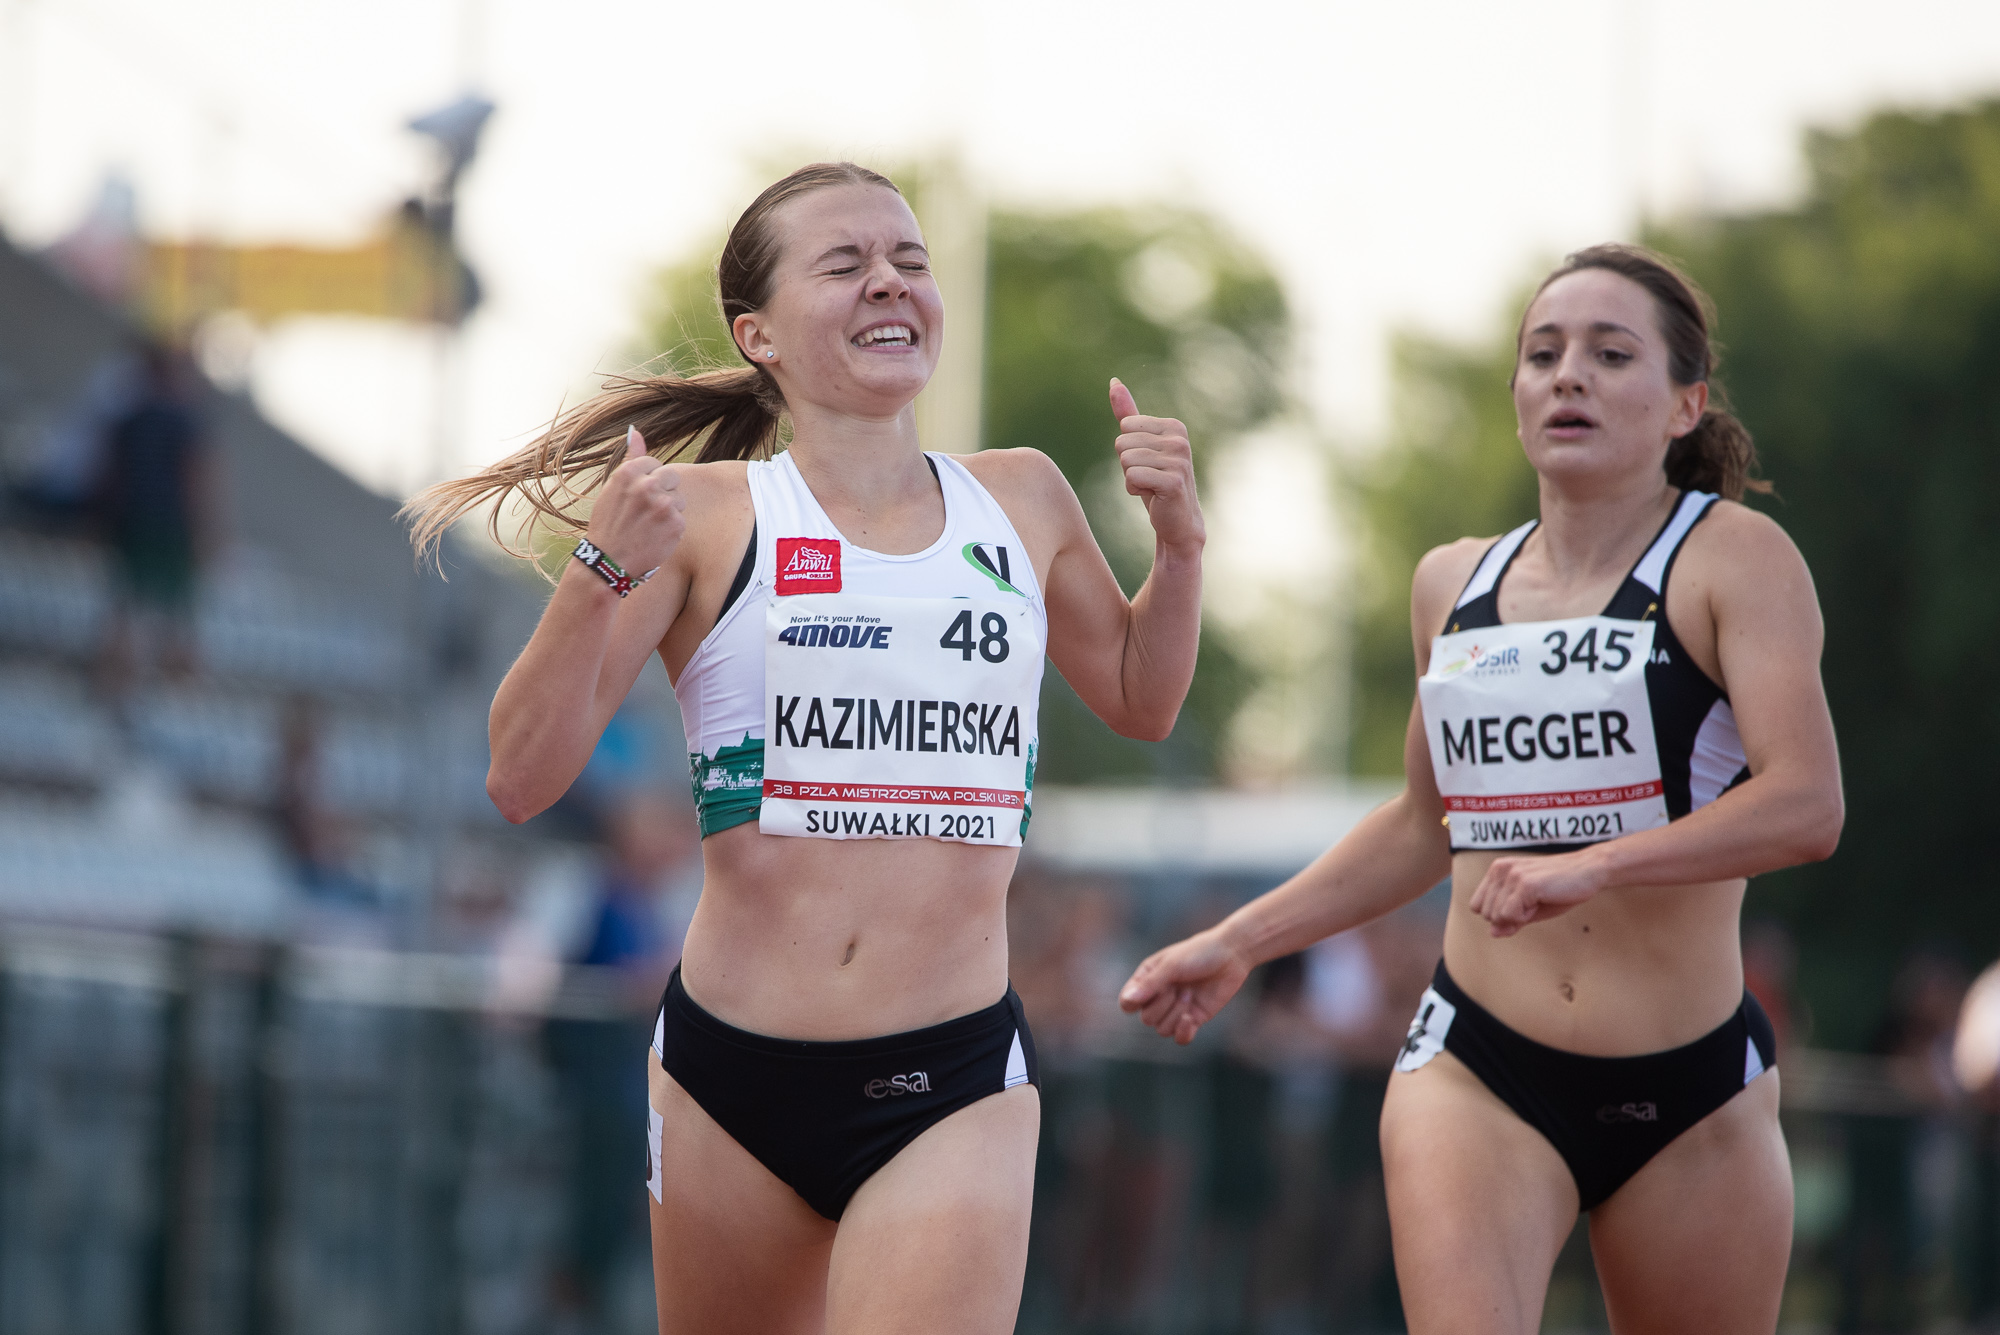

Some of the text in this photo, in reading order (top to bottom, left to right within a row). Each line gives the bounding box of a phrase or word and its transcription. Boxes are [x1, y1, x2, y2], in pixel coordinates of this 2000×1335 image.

[783, 548, 833, 571] Anwil
[784, 573, 807, 581] GRUPA
[790, 615, 881, 625] Now It's your Move
[778, 624, 893, 650] 4MOVE
[939, 610, 1010, 664] 48
[1540, 627, 1635, 675] 345
[775, 695, 1020, 757] KAZIMIERSKA
[1441, 709, 1637, 767] MEGGER
[773, 784, 796, 796] 38.
[799, 786, 839, 797] PZLA
[842, 788, 951, 801] MISTRZOSTWA
[954, 791, 996, 803] POLSKI
[1575, 788, 1622, 805] POLSKI
[1624, 783, 1655, 800] U23
[805, 809, 995, 839] SUWAŁKI 2021
[1470, 812, 1624, 843] SUWAŁKI 2021
